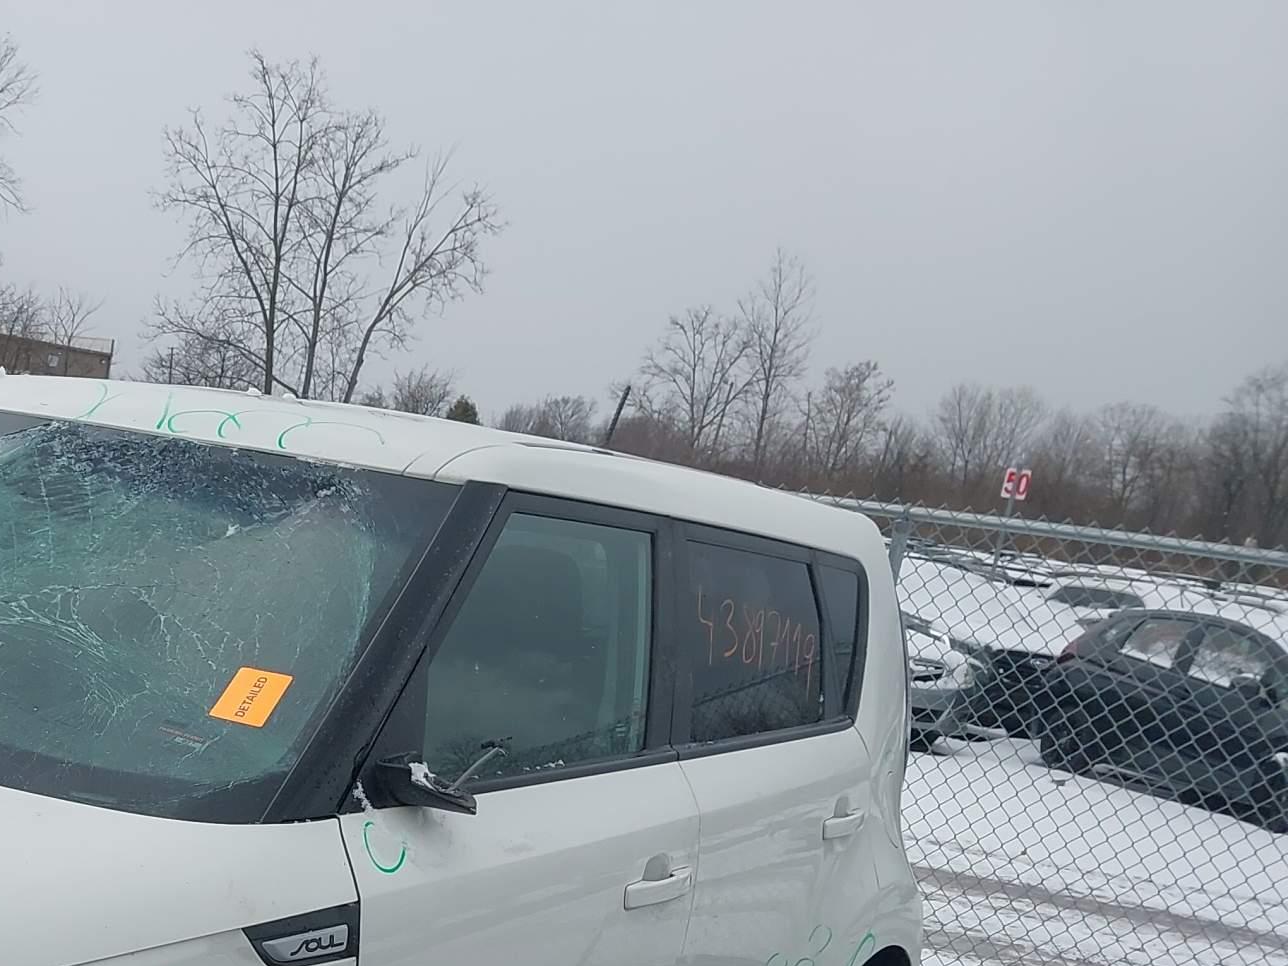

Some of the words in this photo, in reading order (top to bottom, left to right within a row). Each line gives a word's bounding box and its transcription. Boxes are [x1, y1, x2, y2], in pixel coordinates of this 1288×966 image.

[1004, 471, 1030, 495] 50
[696, 585, 817, 702] 43897119
[234, 676, 268, 718] DETAILED
[290, 934, 345, 956] SOUL
